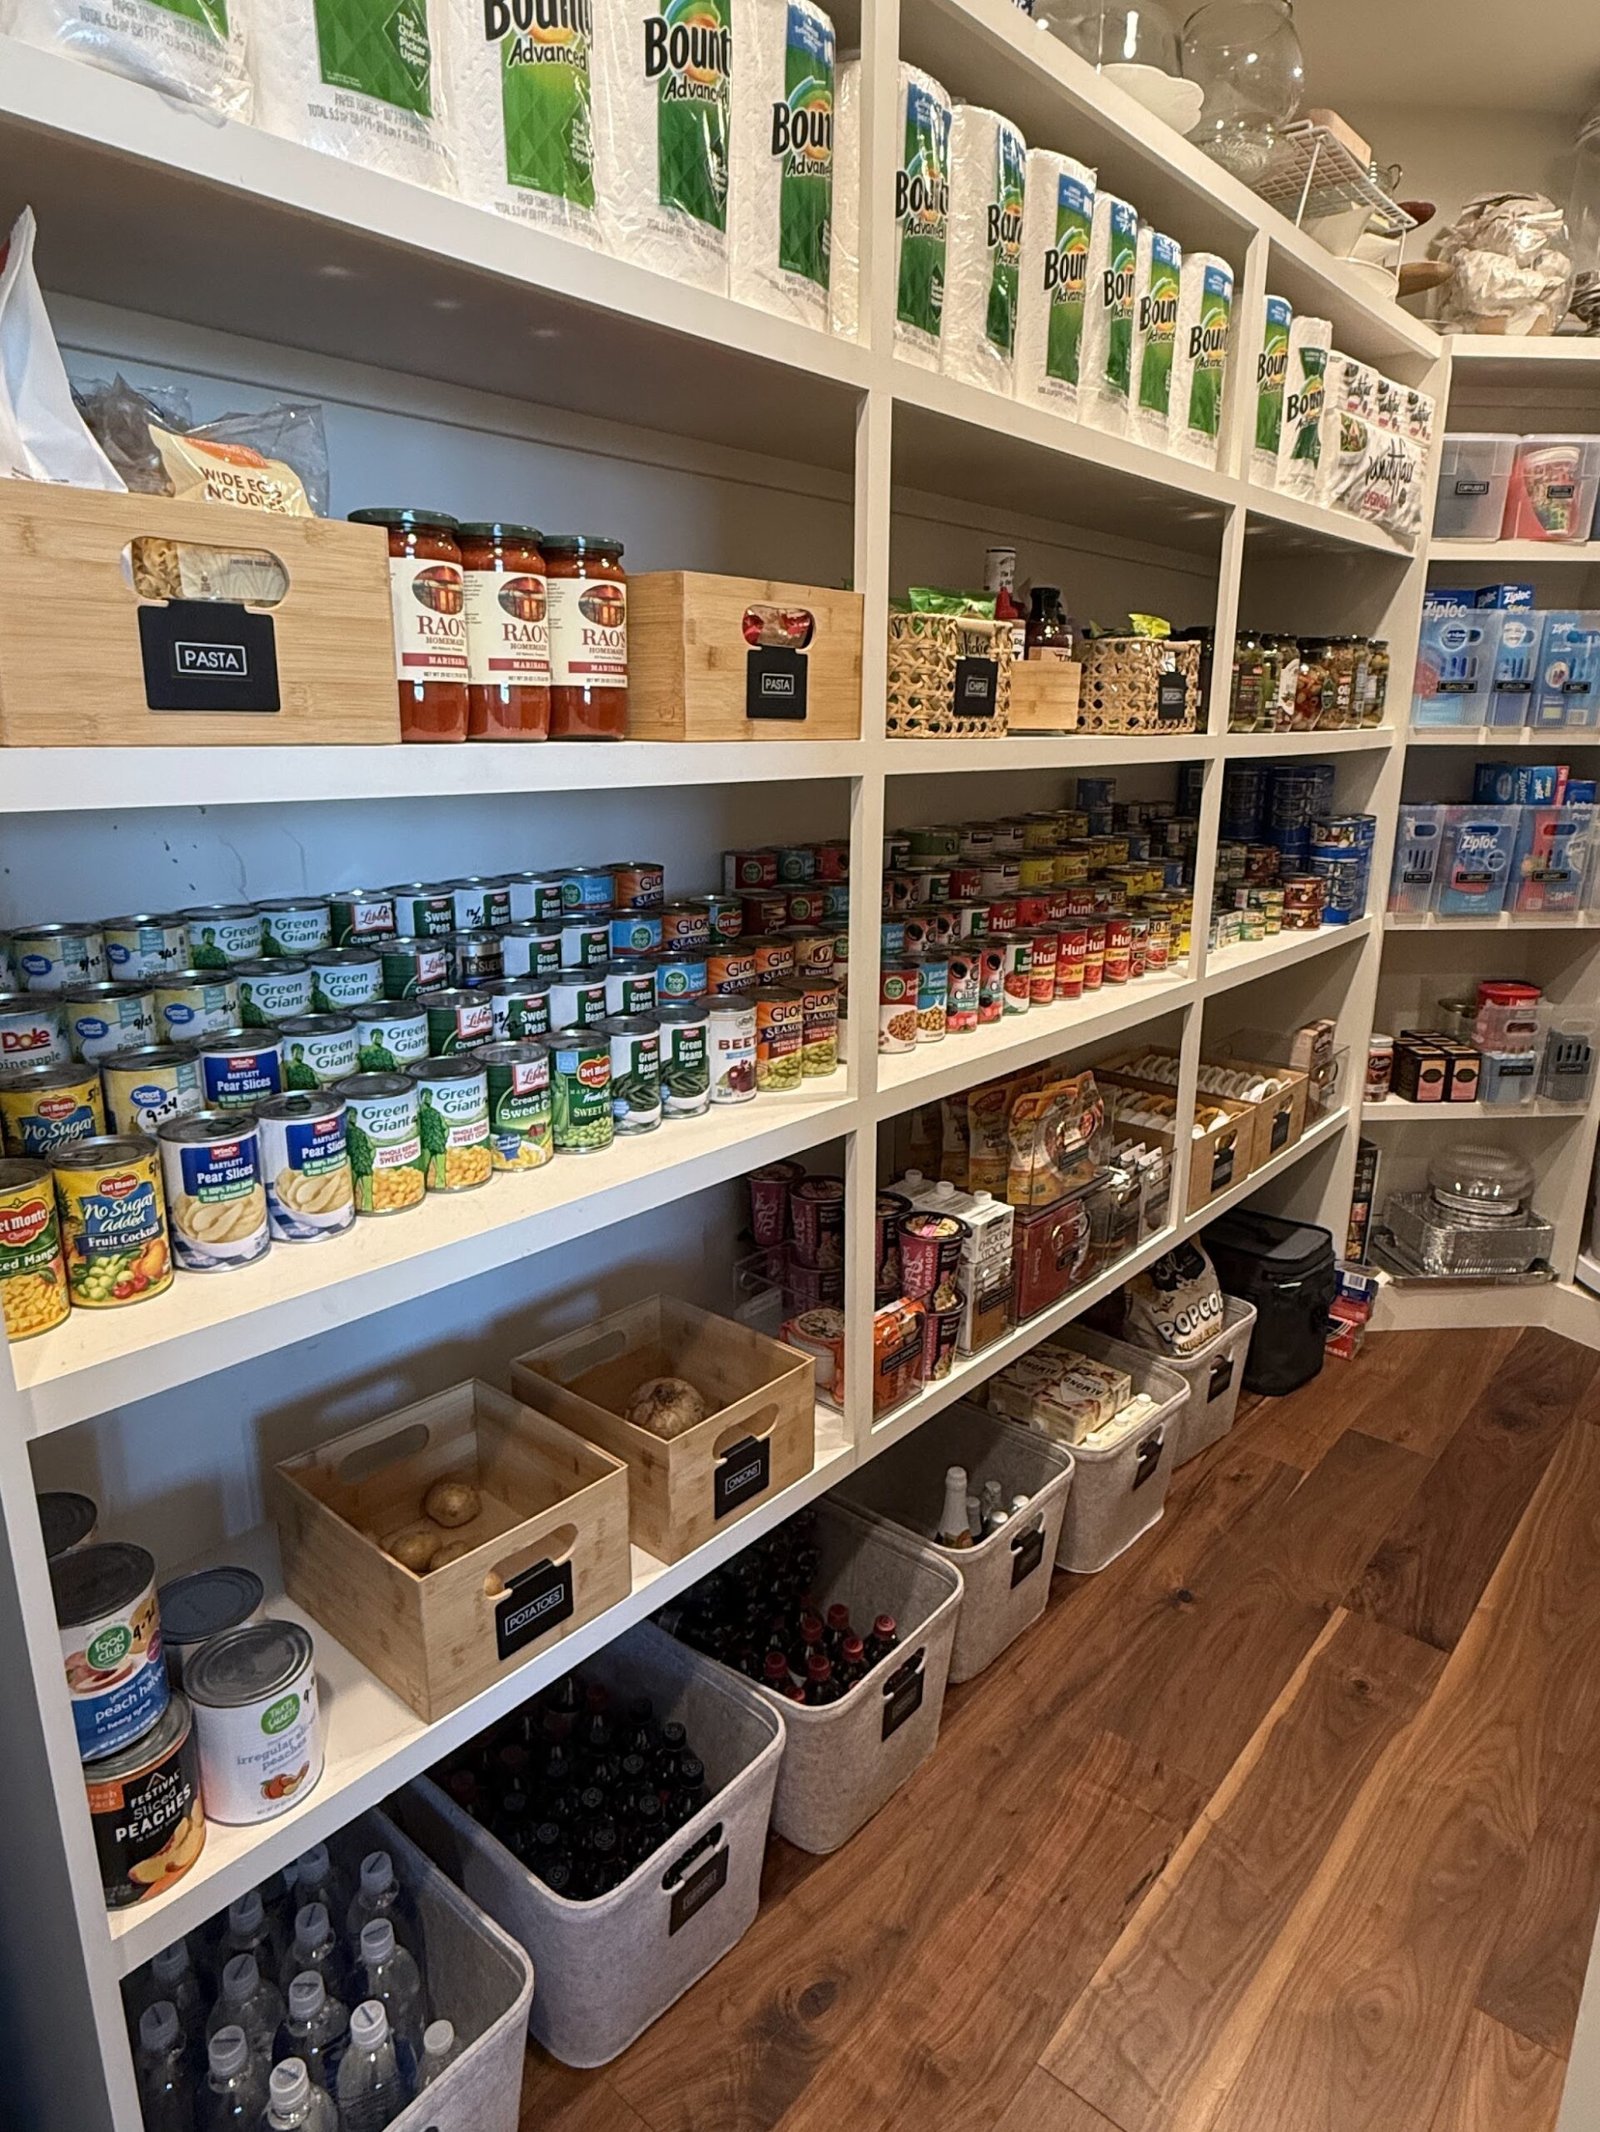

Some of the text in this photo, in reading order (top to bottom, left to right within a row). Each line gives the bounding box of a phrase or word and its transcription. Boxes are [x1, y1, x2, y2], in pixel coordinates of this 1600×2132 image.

[508, 37, 588, 73] Advanced
[200, 467, 242, 491] WIDE
[1503, 590, 1533, 605] Ziploc
[1423, 601, 1468, 623] Ziploc
[184, 649, 240, 670] PASTA
[765, 678, 791, 692] PASTA
[968, 680, 986, 692] CHIPS
[1460, 835, 1499, 852] Ziploc
[219, 924, 259, 939] Green
[275, 917, 319, 931] Green
[429, 923, 451, 935] Peas
[281, 929, 318, 943] Giant
[350, 934, 380, 945] Cream
[537, 953, 558, 964] Green
[323, 971, 368, 985] Green
[255, 982, 303, 997] Green
[330, 984, 369, 998] Giant
[630, 991, 652, 1002] Green
[262, 994, 304, 1010] Giant
[585, 1001, 606, 1012] Green
[630, 1002, 653, 1013] Beans
[520, 1009, 548, 1023] Sweet
[387, 1024, 427, 1040] Green
[525, 1022, 547, 1035] Peas
[1, 1027, 50, 1050] Dole
[455, 1038, 483, 1050] Cream
[679, 1039, 703, 1051] Green
[307, 1039, 353, 1056] Green
[316, 1054, 354, 1069] Giant
[638, 1051, 659, 1063] Green
[679, 1050, 703, 1062] Beans
[227, 1069, 260, 1080] BARTLETT
[580, 1067, 594, 1078] Del
[216, 1076, 271, 1092] Pear Slices
[132, 1090, 161, 1100] Great
[436, 1084, 481, 1101] Green
[510, 1092, 540, 1107] Cream
[361, 1103, 409, 1120] Green
[443, 1096, 481, 1114] Giant
[500, 1104, 540, 1121] Sweet
[573, 1104, 602, 1119] SWEET
[24, 1116, 95, 1140] No Sugar
[368, 1115, 410, 1134] Giant
[312, 1132, 342, 1145] BARTLETT
[452, 1133, 475, 1145] SWEET
[301, 1146, 326, 1160] Pear
[379, 1153, 403, 1166] SWEET
[208, 1157, 244, 1171] BARTLETT
[196, 1164, 254, 1185] Pear Slices
[113, 1178, 138, 1190] Monte
[84, 1191, 156, 1221] No Sugar
[11, 1209, 47, 1231] Monte
[99, 1211, 146, 1234] Added
[87, 1221, 160, 1248] Fruit Cocktail
[979, 1229, 1011, 1252] CHICKEN
[1062, 1374, 1105, 1397] ALMOND
[727, 1464, 759, 1490] ONIONS
[508, 1589, 562, 1631] POTATOES
[95, 1631, 126, 1651] food
[97, 1643, 126, 1662] club
[95, 1692, 139, 1725] peach
[107, 1713, 133, 1731] heavy
[236, 1737, 294, 1767] irregular
[129, 1769, 181, 1809] FESTIVAL
[133, 1786, 178, 1822] Sliced
[114, 1782, 192, 1843] PEACHES
